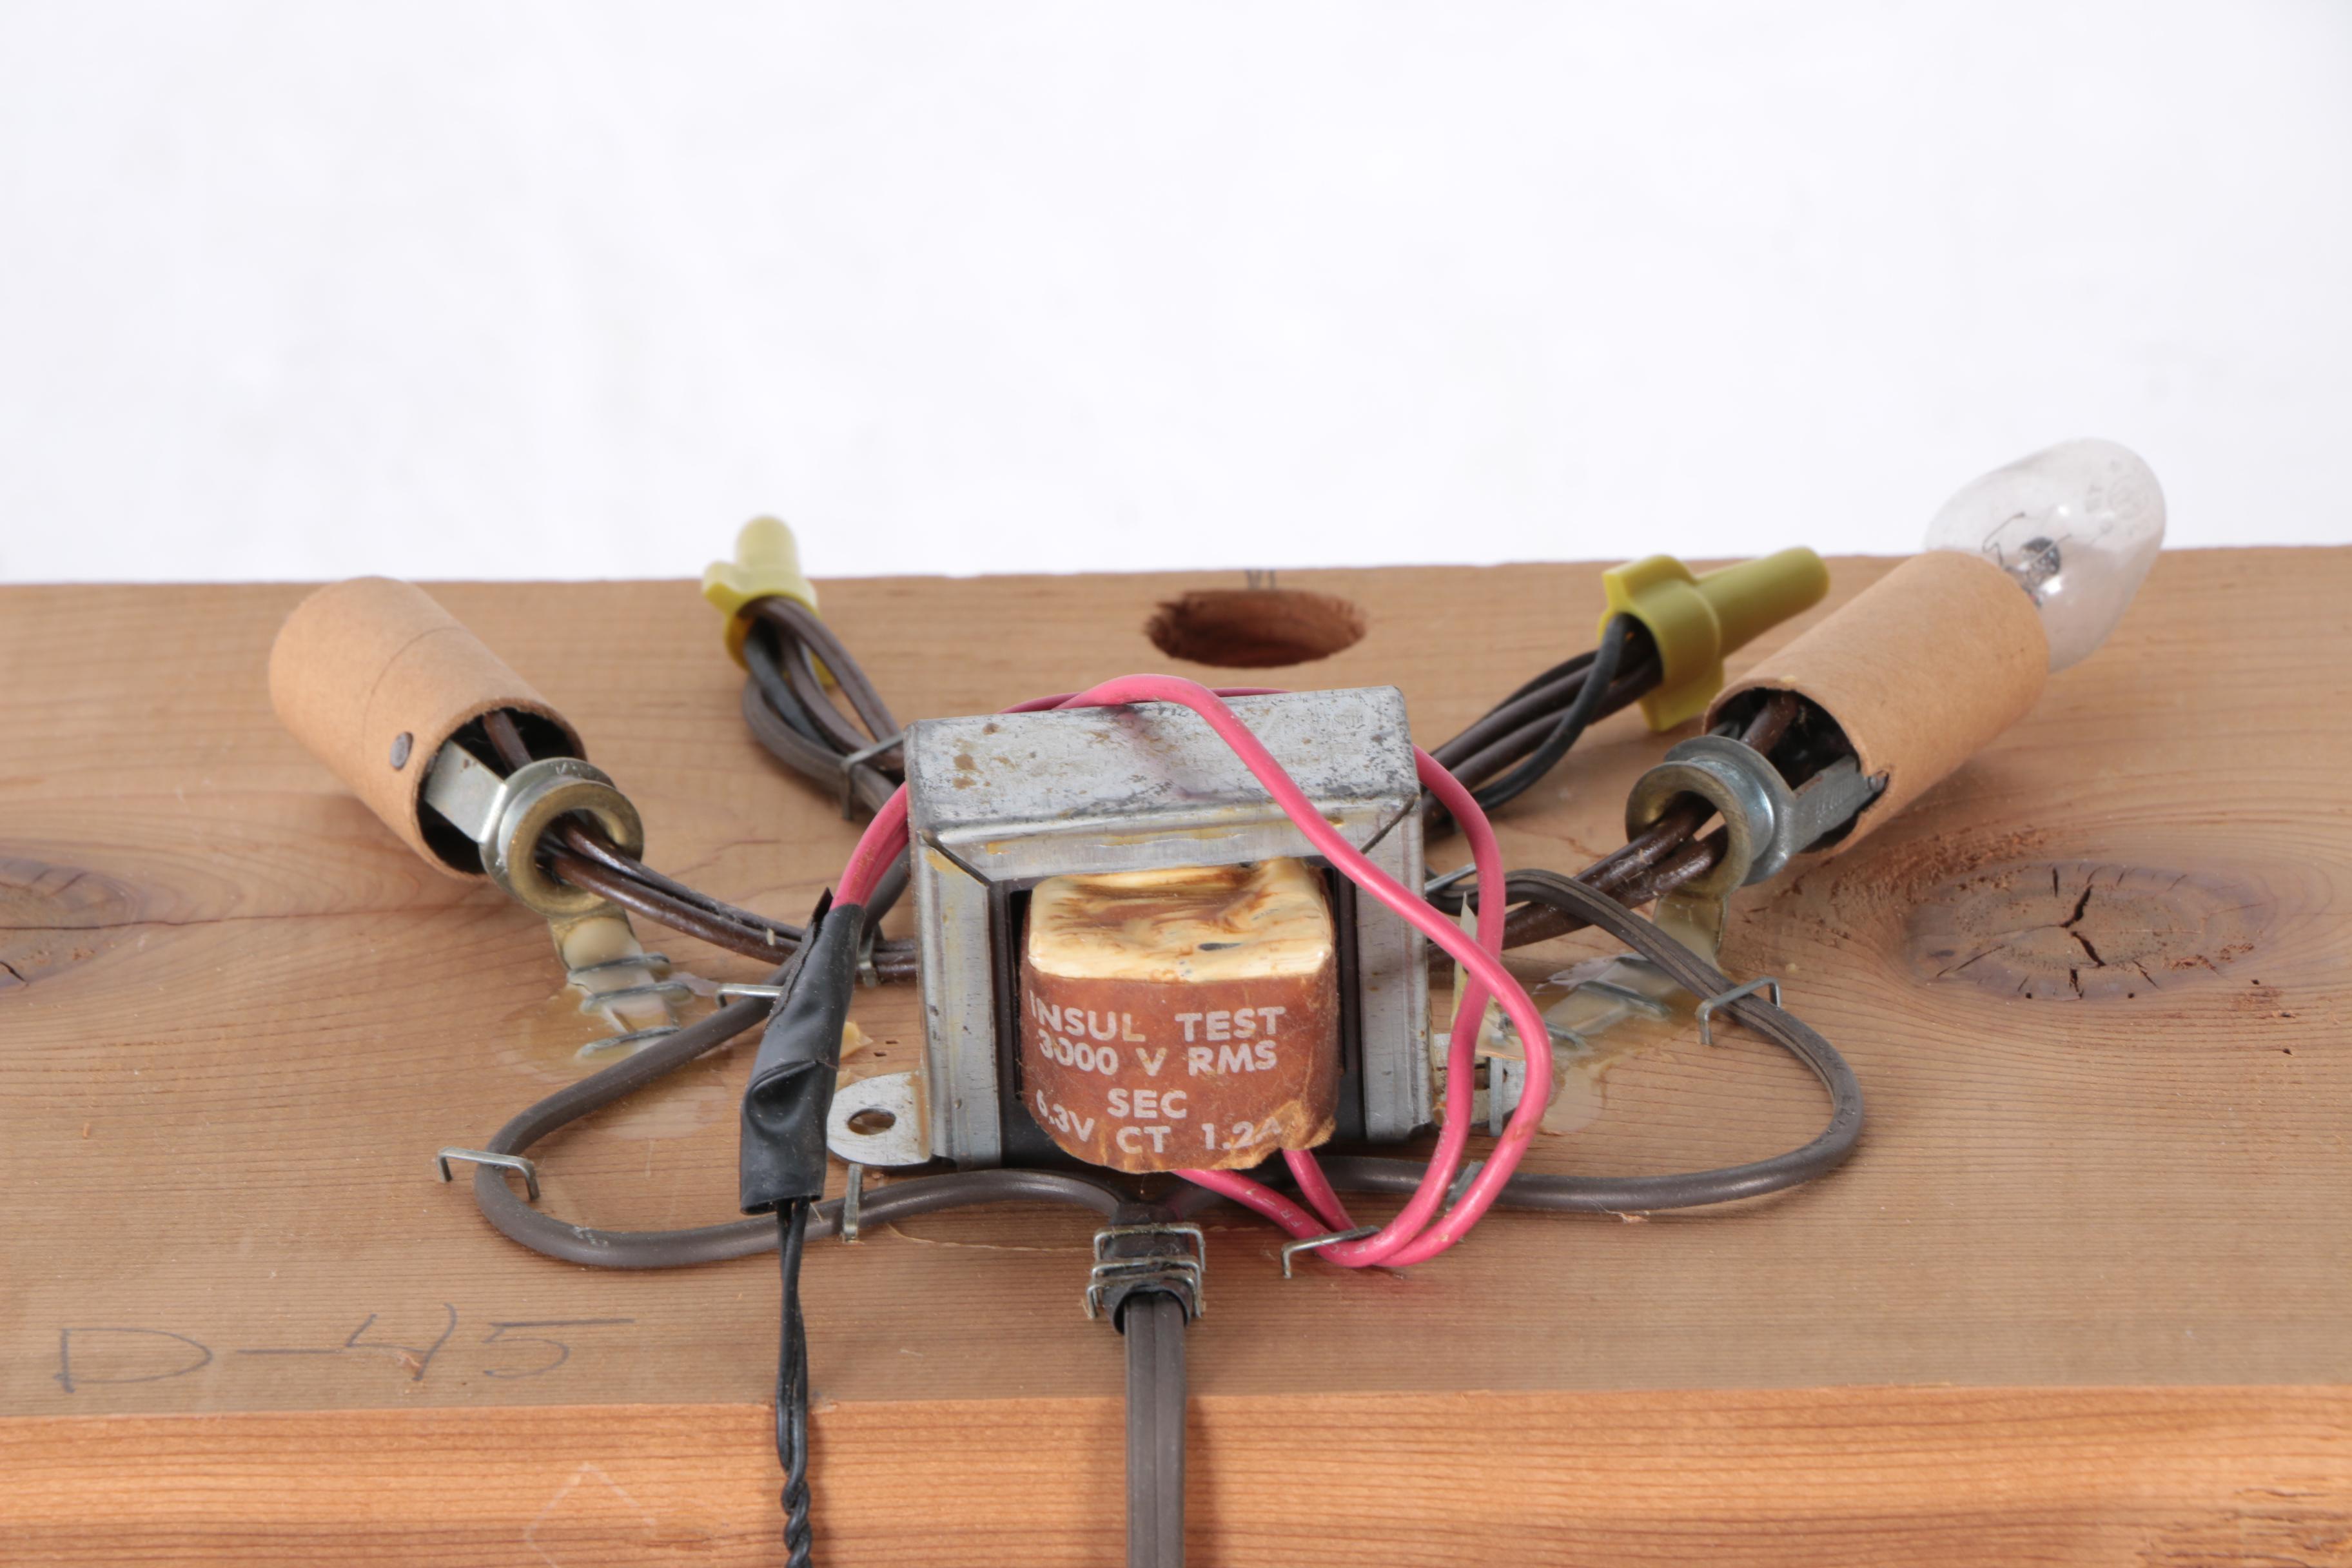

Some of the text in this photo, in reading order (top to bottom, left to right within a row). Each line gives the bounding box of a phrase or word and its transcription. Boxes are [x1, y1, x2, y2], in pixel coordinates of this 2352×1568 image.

[1030, 990, 1286, 1043] INSUL TEST
[1038, 1028, 1277, 1077] 3000 V RMS
[1036, 1089, 1095, 1142] 6.3V
[1116, 1125, 1171, 1154] CT
[1107, 1088, 1187, 1119] SEC
